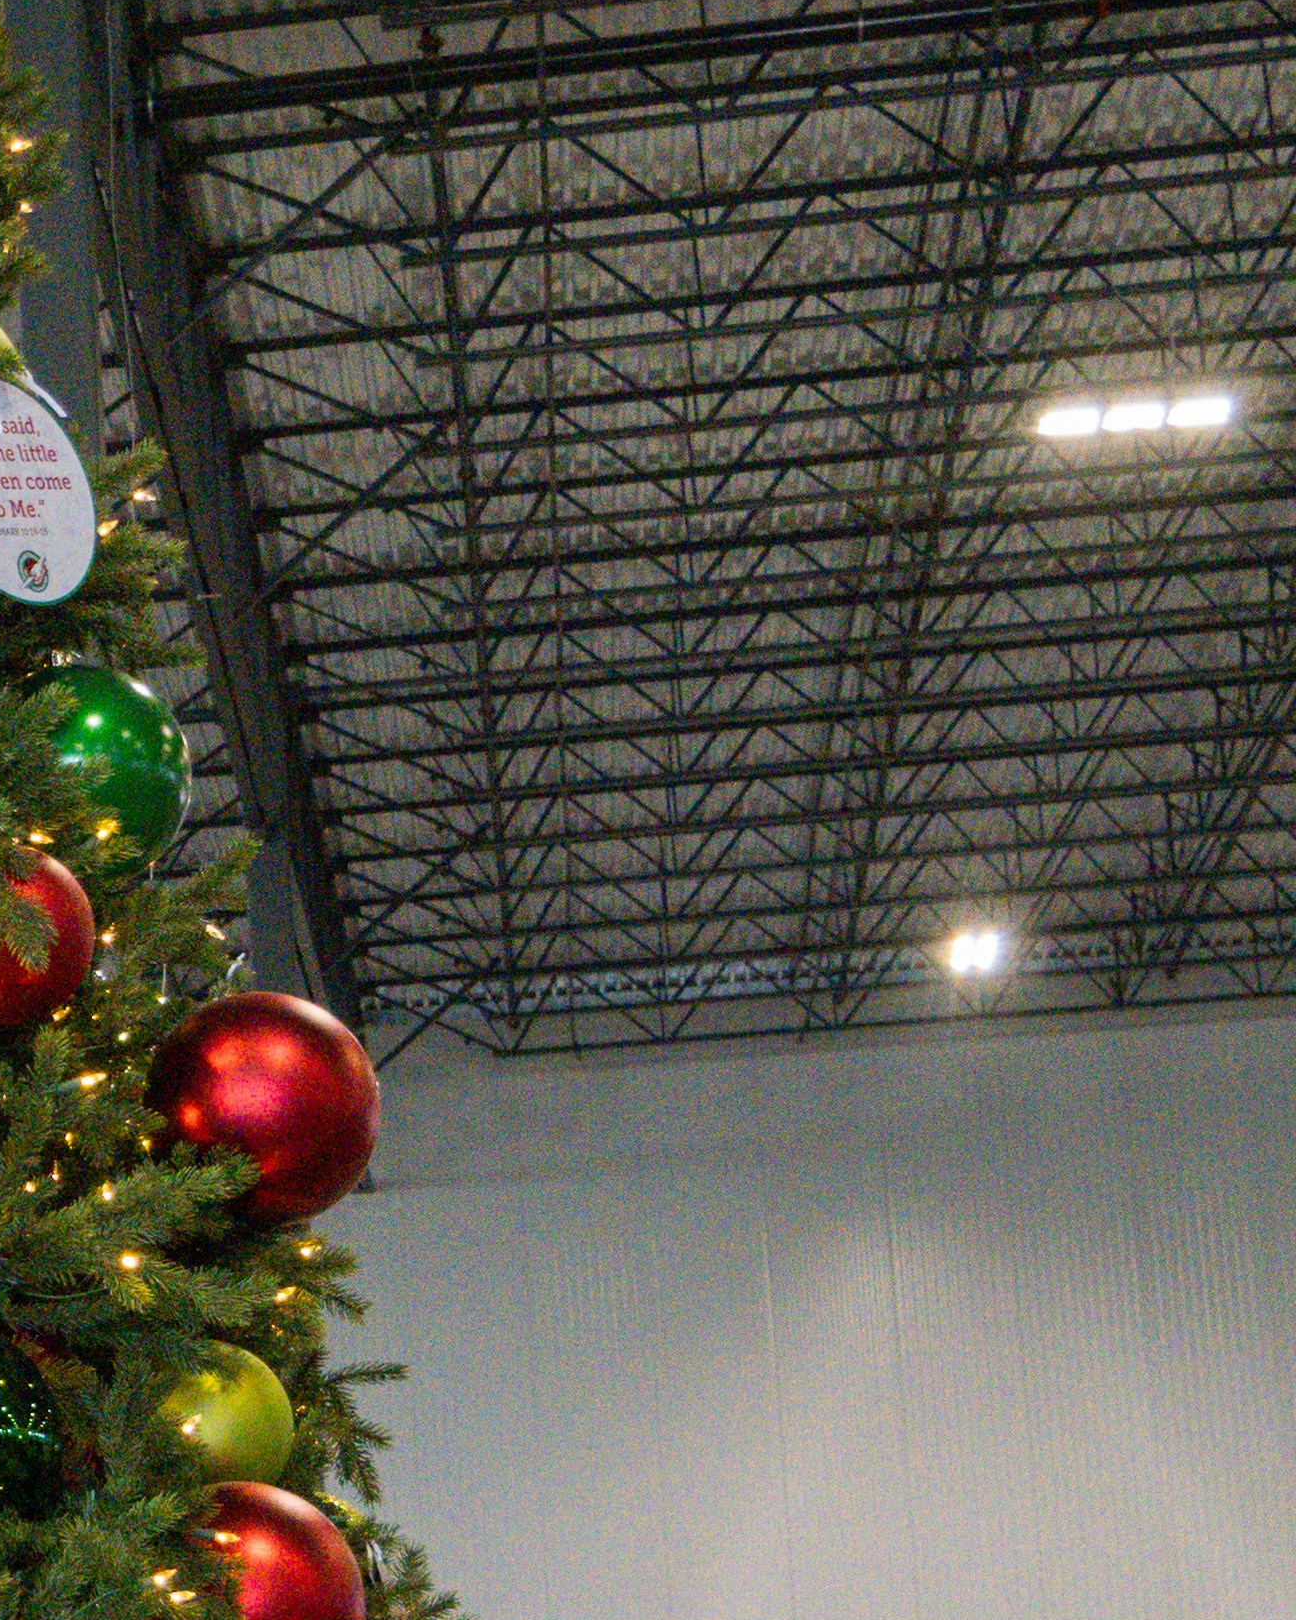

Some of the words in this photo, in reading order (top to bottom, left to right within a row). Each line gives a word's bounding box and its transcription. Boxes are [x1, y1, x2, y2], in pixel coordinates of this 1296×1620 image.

[2, 417, 41, 437] said,
[17, 444, 58, 463] little
[26, 476, 72, 491] come
